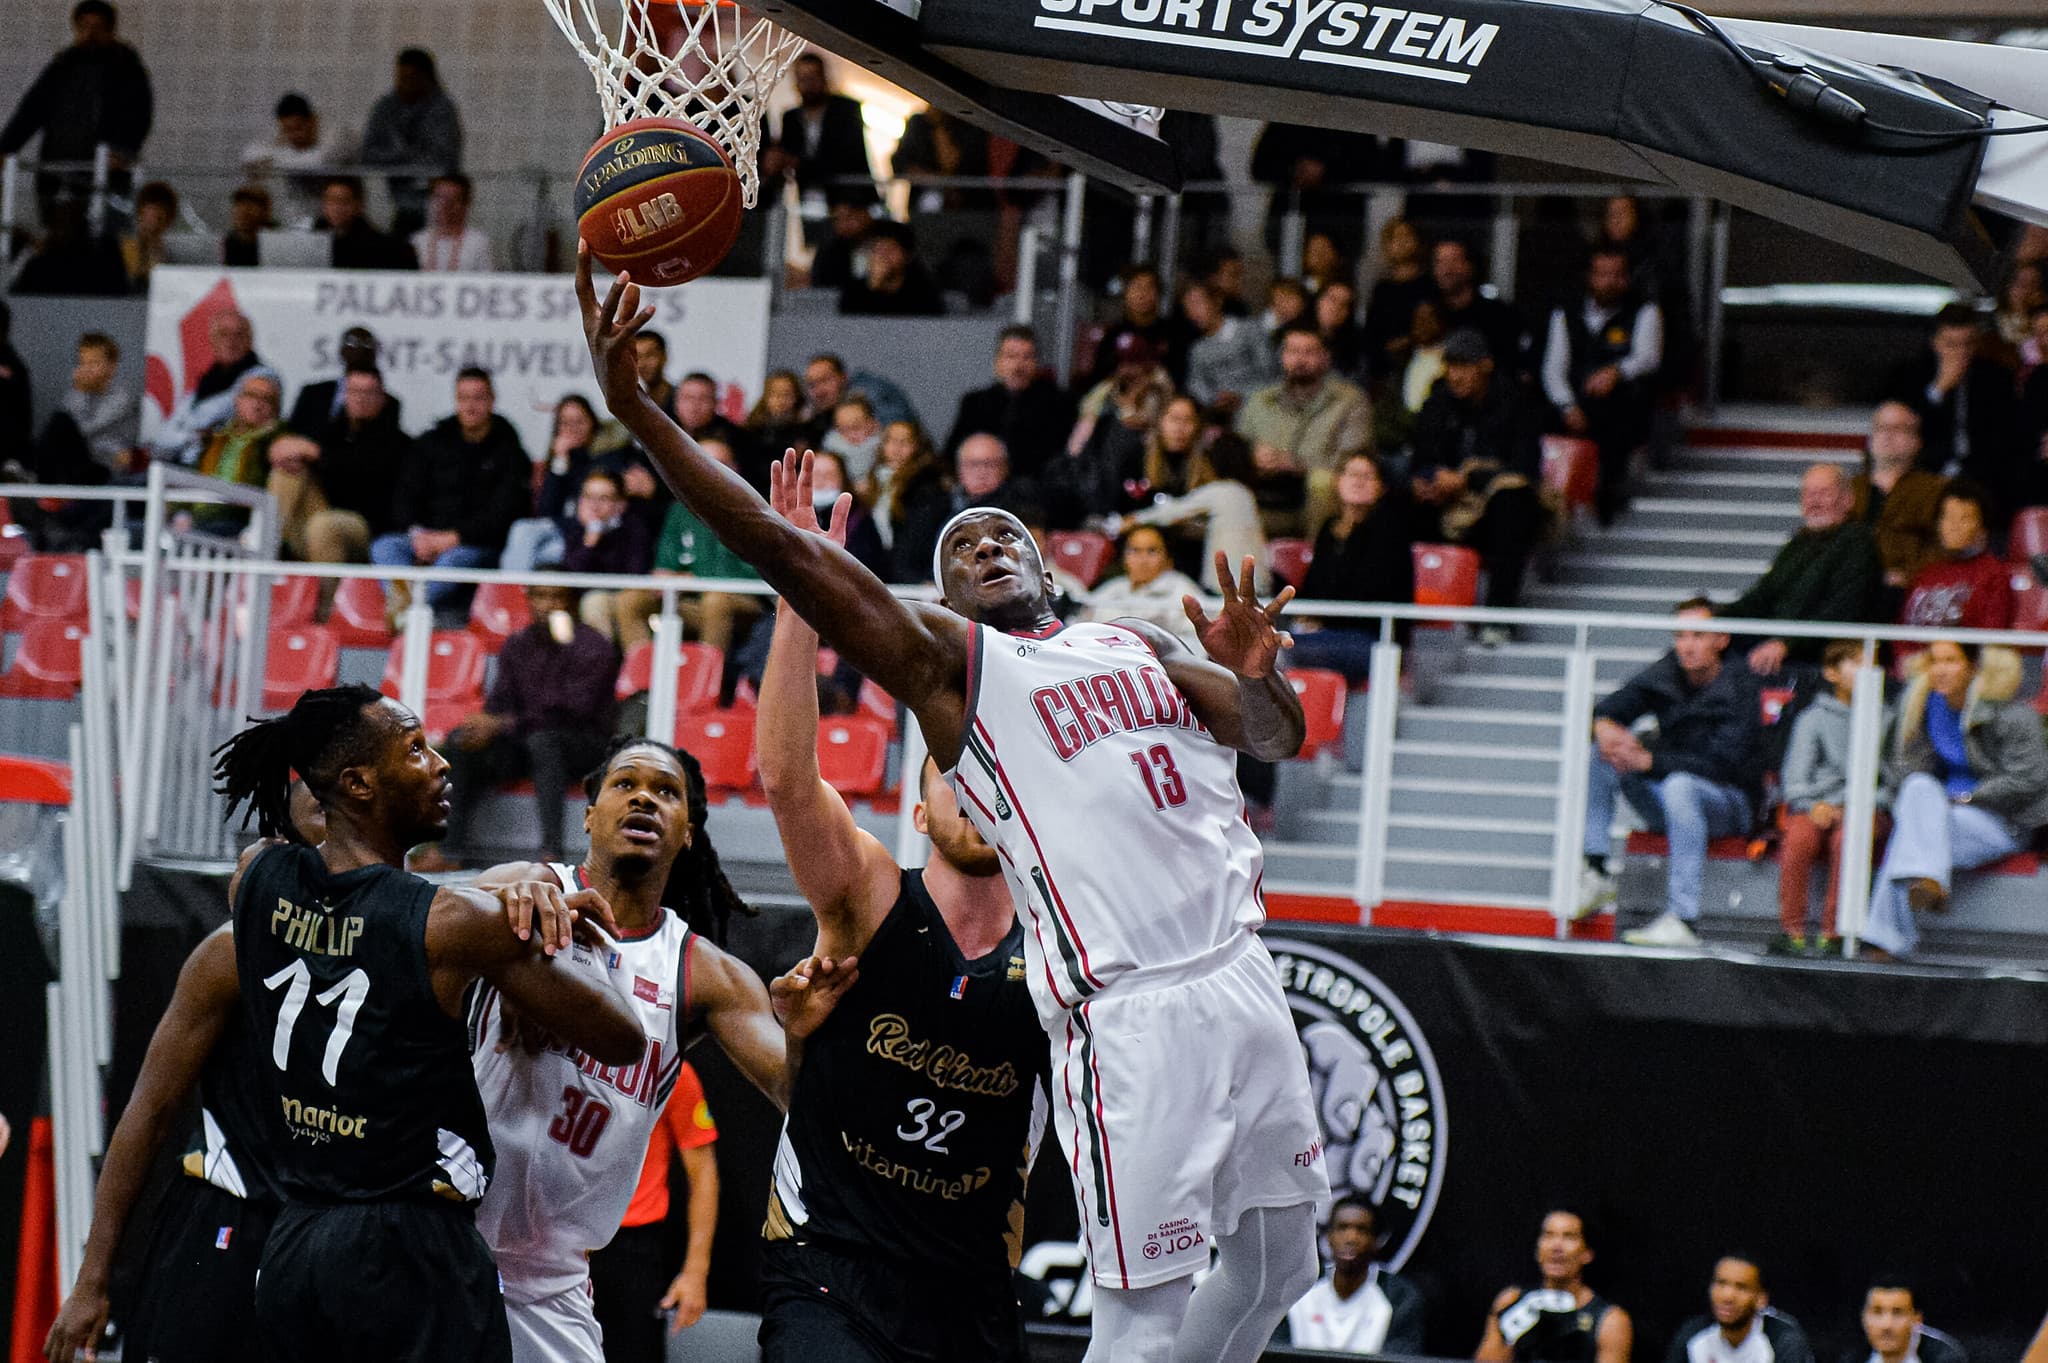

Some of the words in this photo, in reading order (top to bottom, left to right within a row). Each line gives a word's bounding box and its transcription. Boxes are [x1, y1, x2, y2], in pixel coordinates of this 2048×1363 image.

[1040, 0, 1499, 66] ORTSYSTEM
[584, 142, 693, 199] SPALDING
[625, 193, 682, 236] LNB
[315, 282, 446, 318] PALAIS
[453, 284, 527, 321] DES
[536, 285, 686, 323] SPTS
[1128, 743, 1187, 811] 13
[272, 897, 364, 956] PHILLIP
[264, 958, 370, 1087] 11
[867, 1014, 929, 1071] Red
[927, 1045, 1018, 1096] Giants
[548, 1085, 612, 1159] 30
[897, 1098, 966, 1154] 32
[1392, 1069, 1431, 1210] BASKET
[1159, 1218, 1189, 1230] CASINO
[1166, 1231, 1204, 1254] JOA
